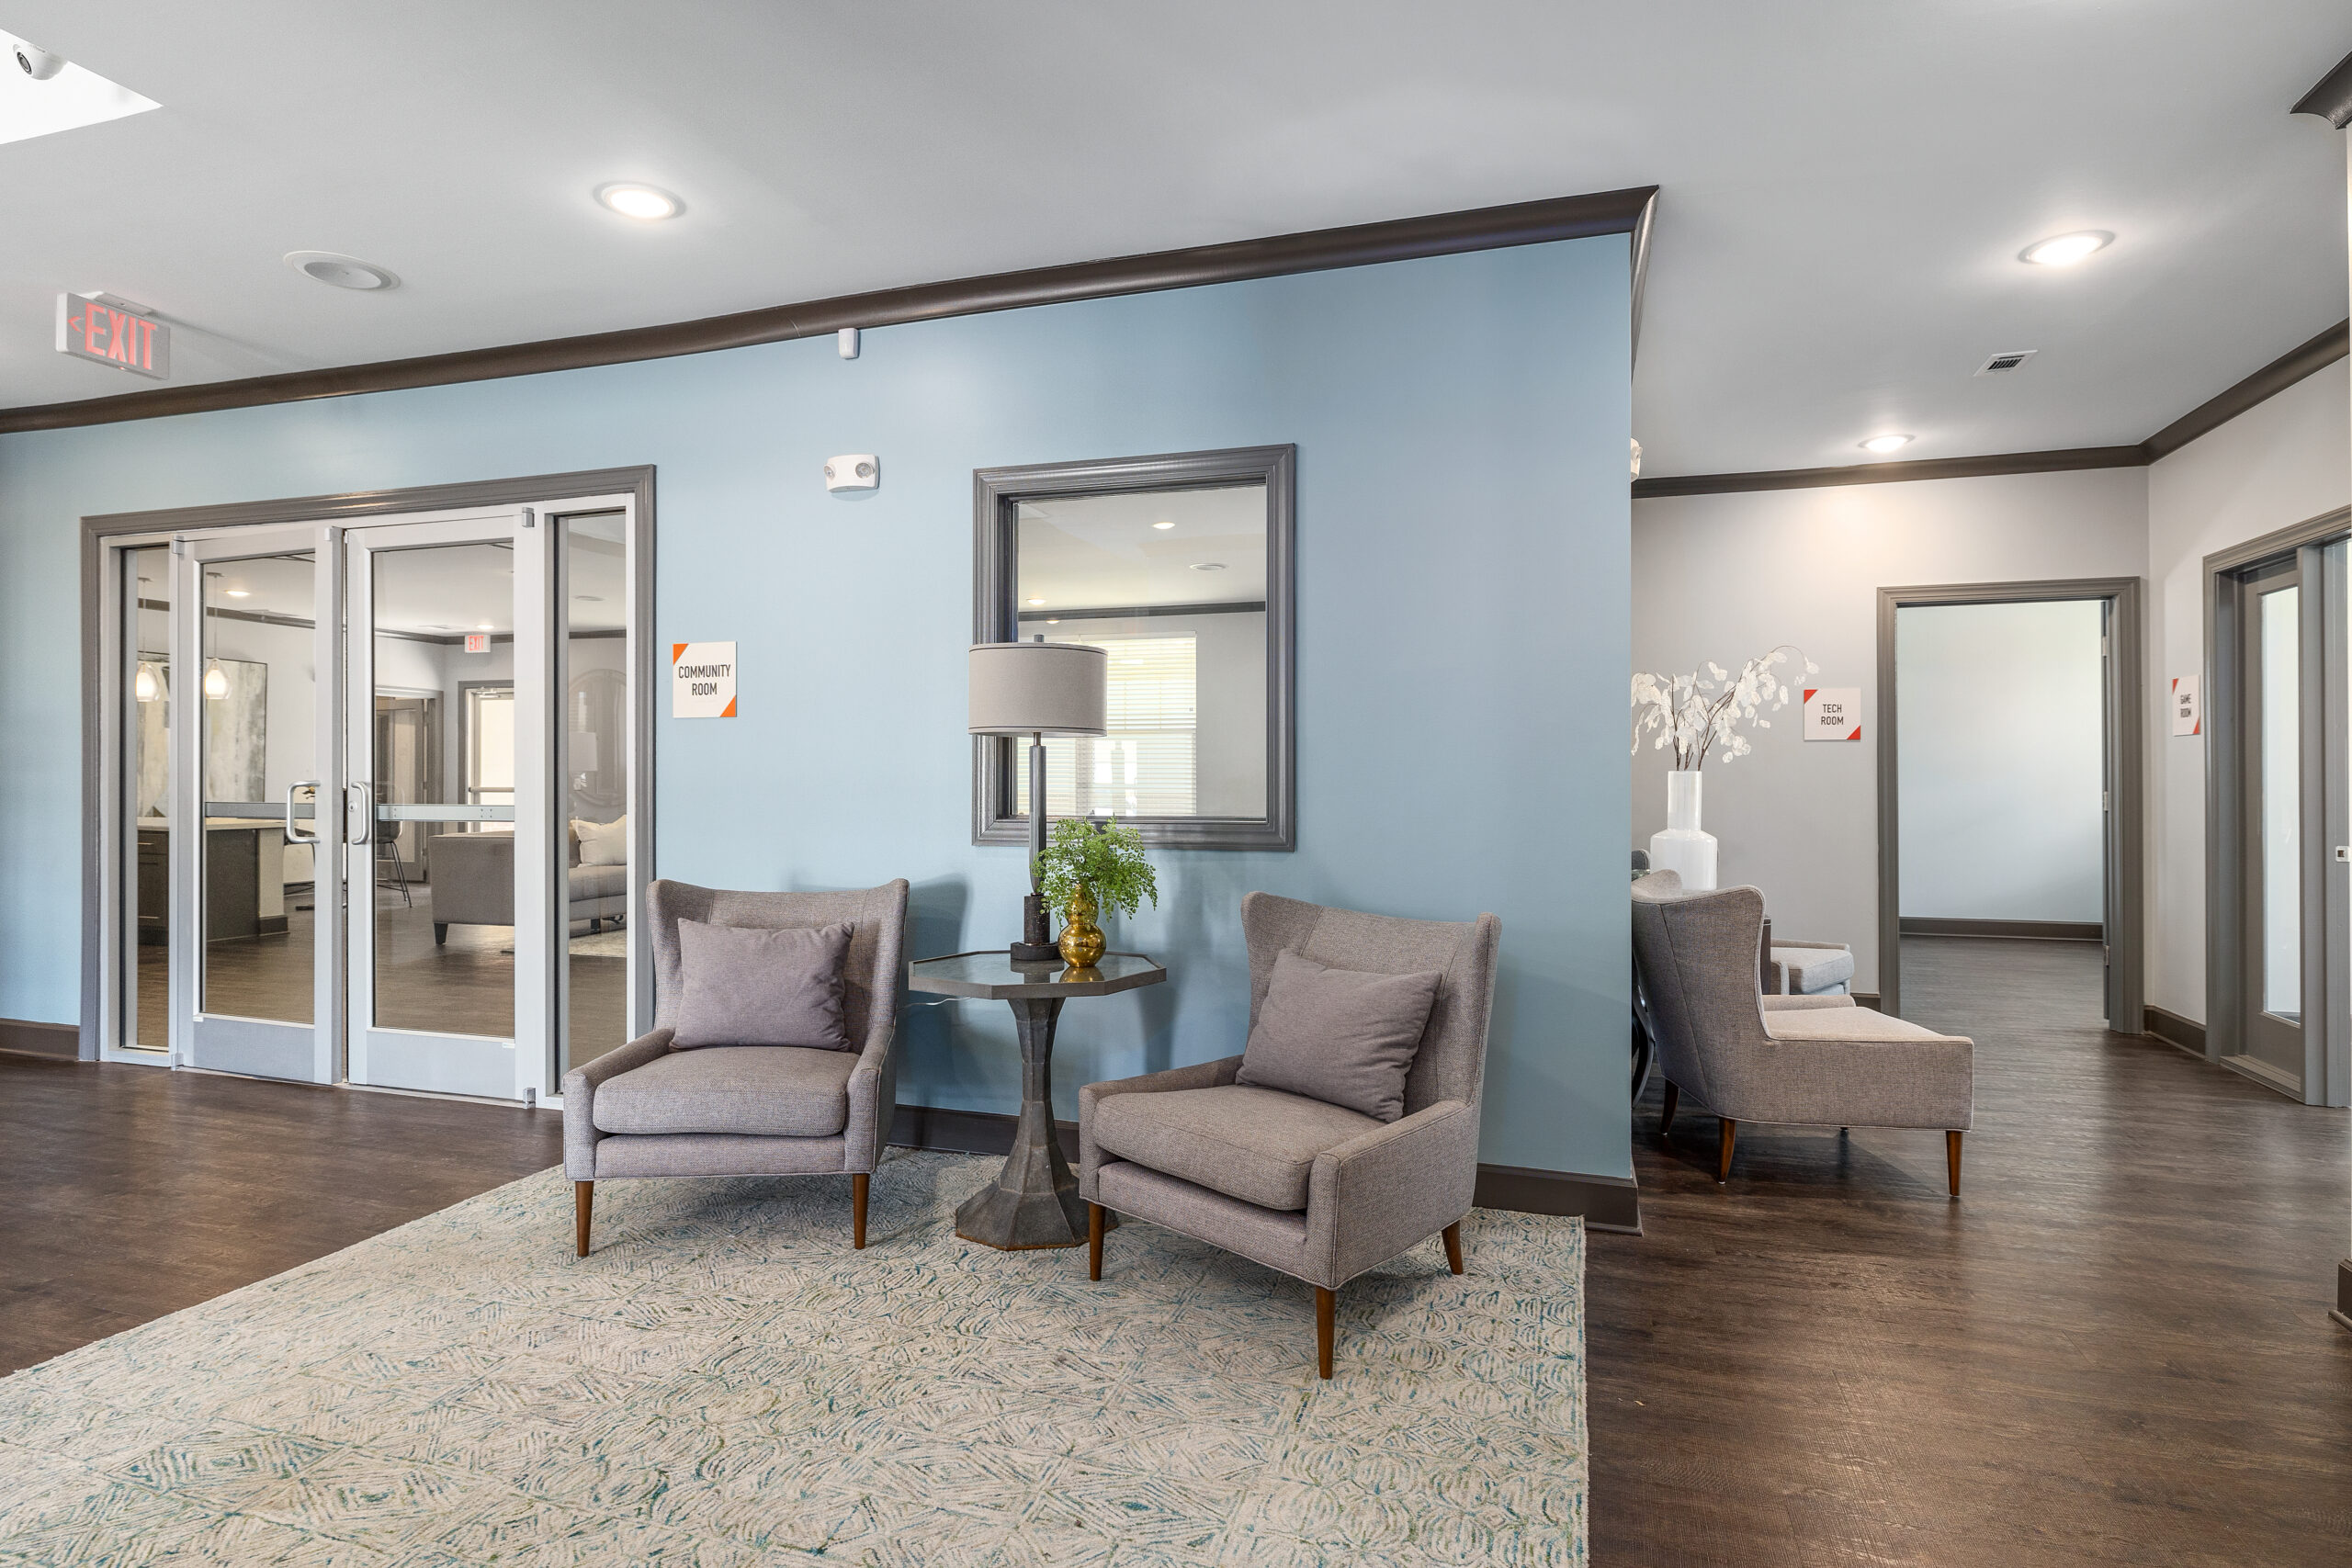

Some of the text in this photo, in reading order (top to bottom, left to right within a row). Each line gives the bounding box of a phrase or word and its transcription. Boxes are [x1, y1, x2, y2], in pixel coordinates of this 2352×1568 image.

[85, 301, 157, 370] EXIT
[469, 635, 484, 651] EXIT
[678, 664, 731, 679] COMMUNITY
[691, 682, 718, 696] ROOM
[1822, 704, 1842, 714] TECH
[1820, 716, 1844, 726] ROOM
